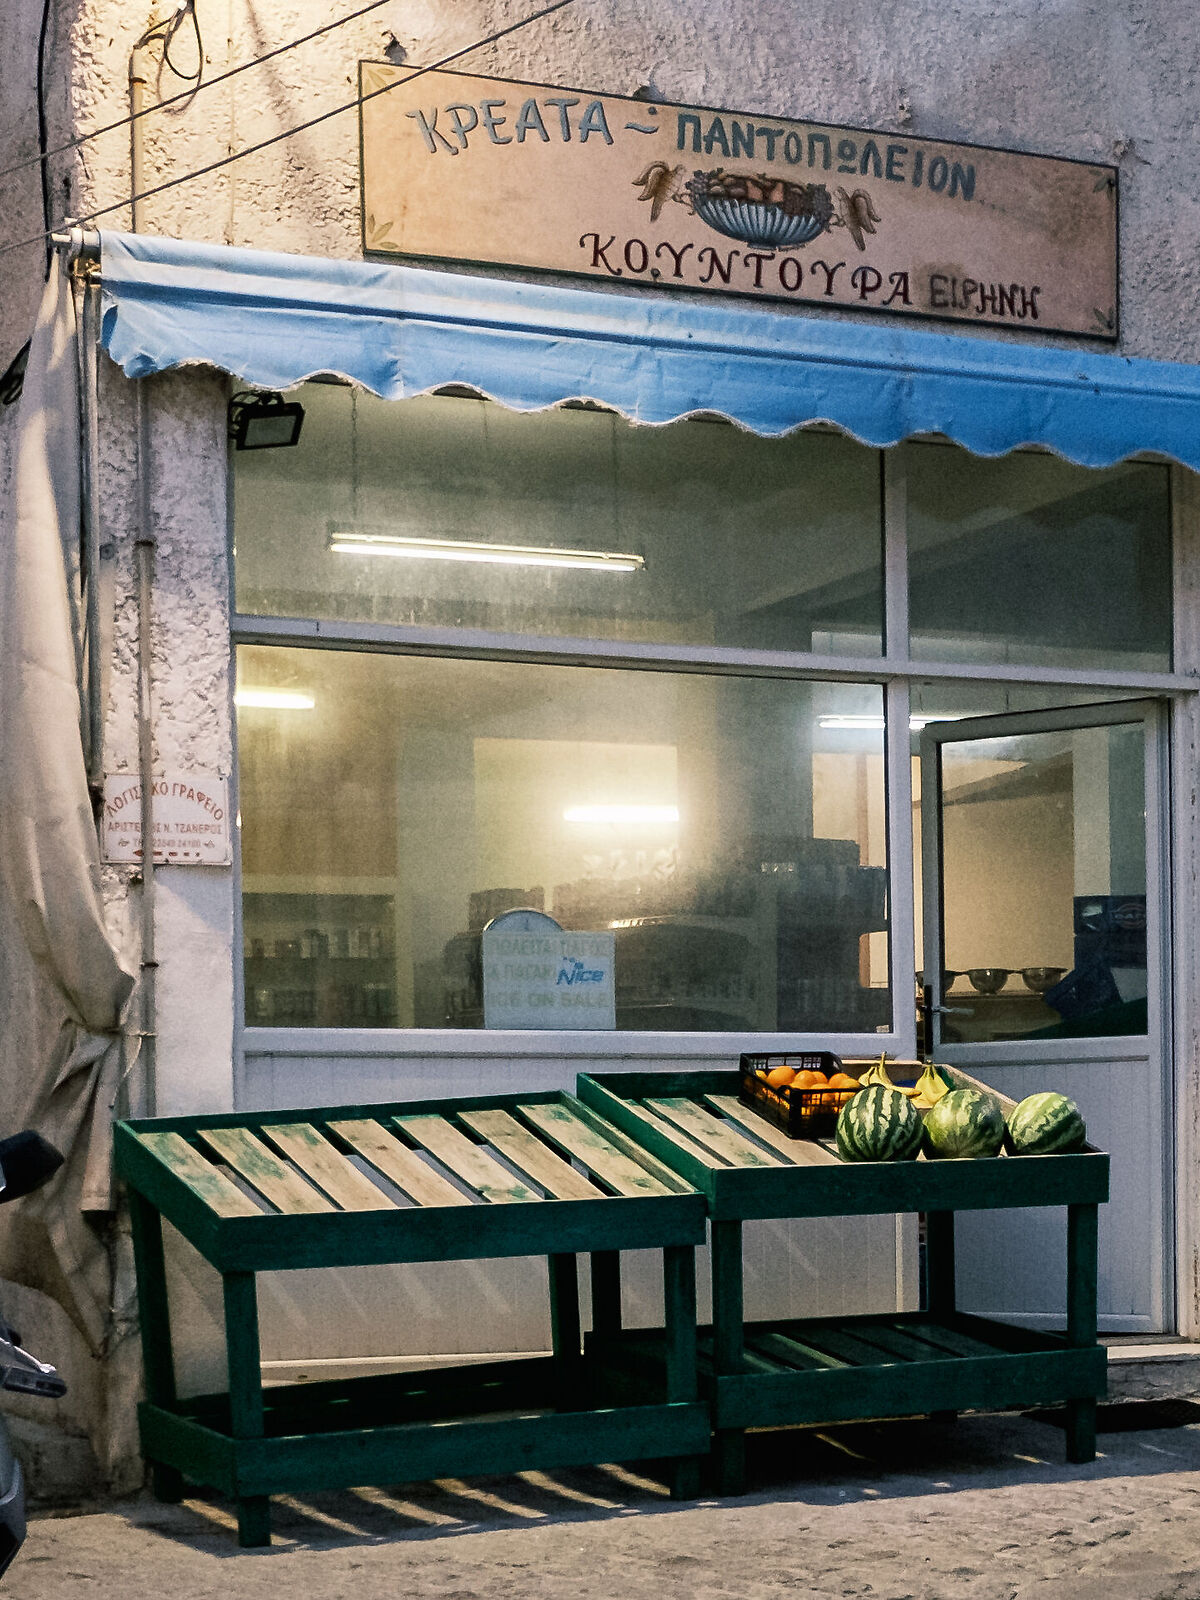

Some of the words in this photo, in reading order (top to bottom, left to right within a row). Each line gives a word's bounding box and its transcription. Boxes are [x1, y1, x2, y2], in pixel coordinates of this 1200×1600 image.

[405, 98, 615, 156] ΚΡΕΑΤΑ
[676, 113, 977, 202] ΠΑΝΤΟΠΩΛΕΙΟΝ
[579, 232, 913, 307] ΚΟΥΝΤΟΥΡΑ
[929, 274, 1041, 321] ΕΙΡΗΝΗ
[172, 782, 224, 821] ΓΡΑΦΕΙΟ
